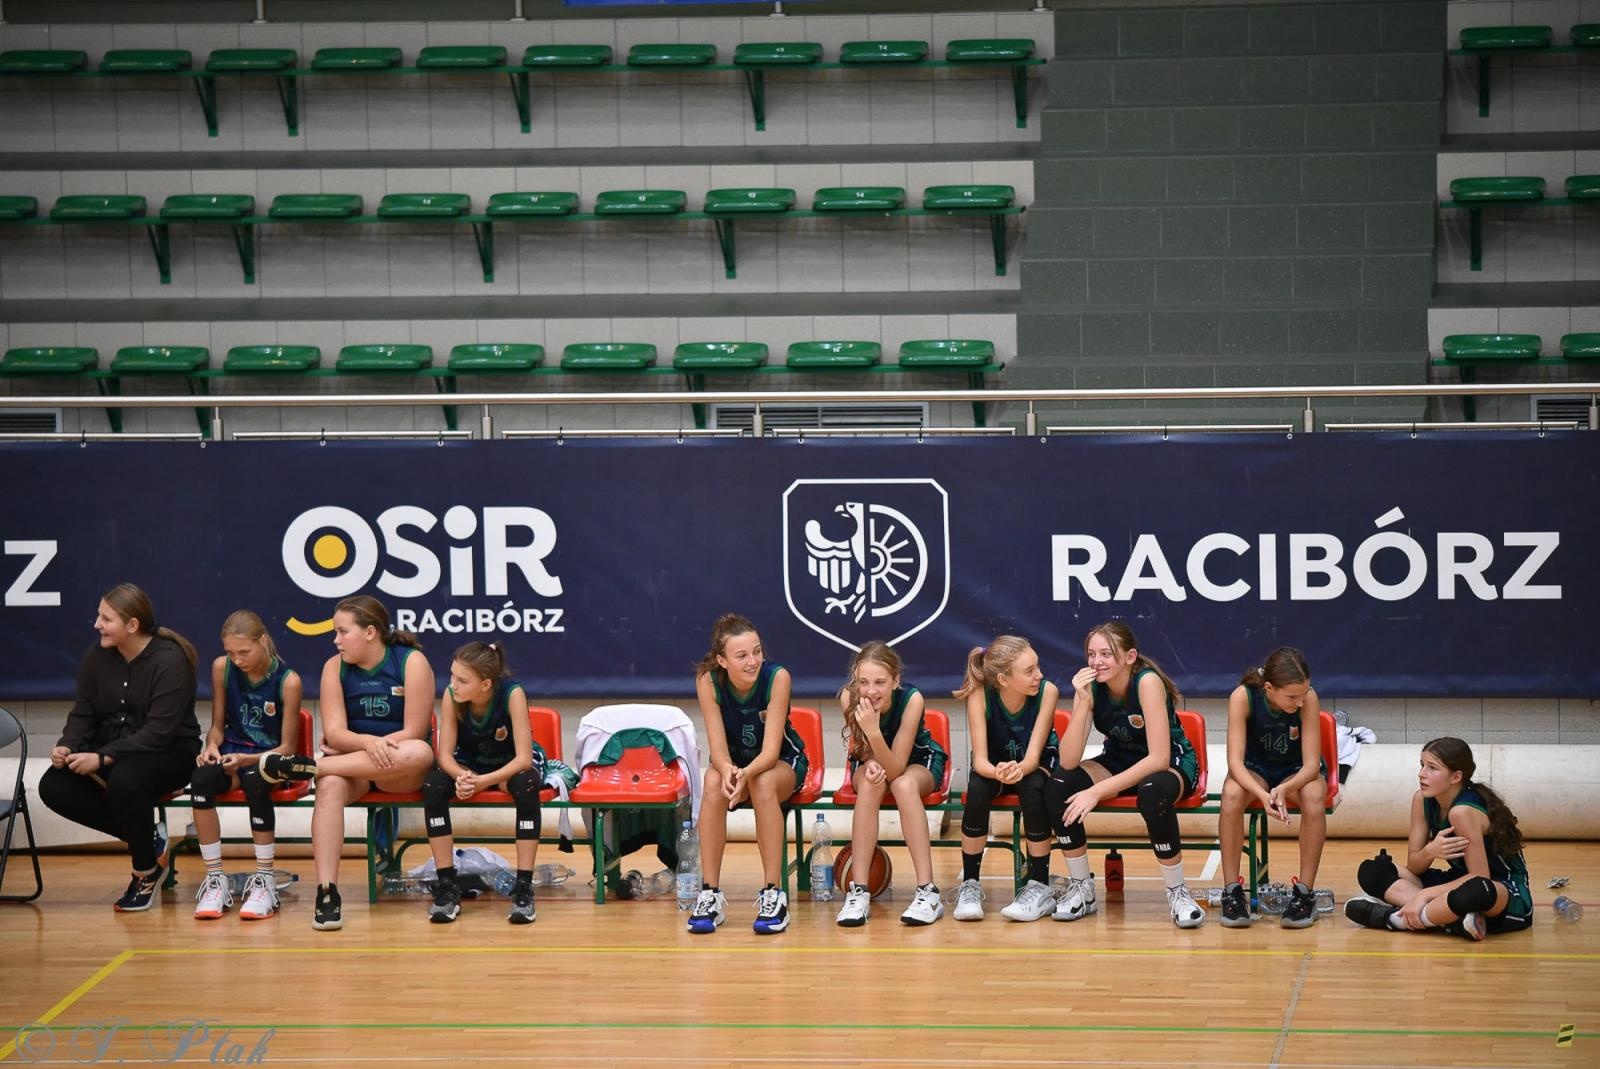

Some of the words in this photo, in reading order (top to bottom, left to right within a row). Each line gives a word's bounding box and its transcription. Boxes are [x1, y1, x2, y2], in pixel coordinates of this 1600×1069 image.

[1052, 507, 1561, 601] RACIBÓRZ
[0, 540, 61, 606] Z
[397, 600, 565, 633] RACIBÓRZ
[240, 703, 263, 728] 12
[360, 696, 391, 717] 15
[742, 724, 757, 747] 5
[1260, 732, 1288, 754] 14
